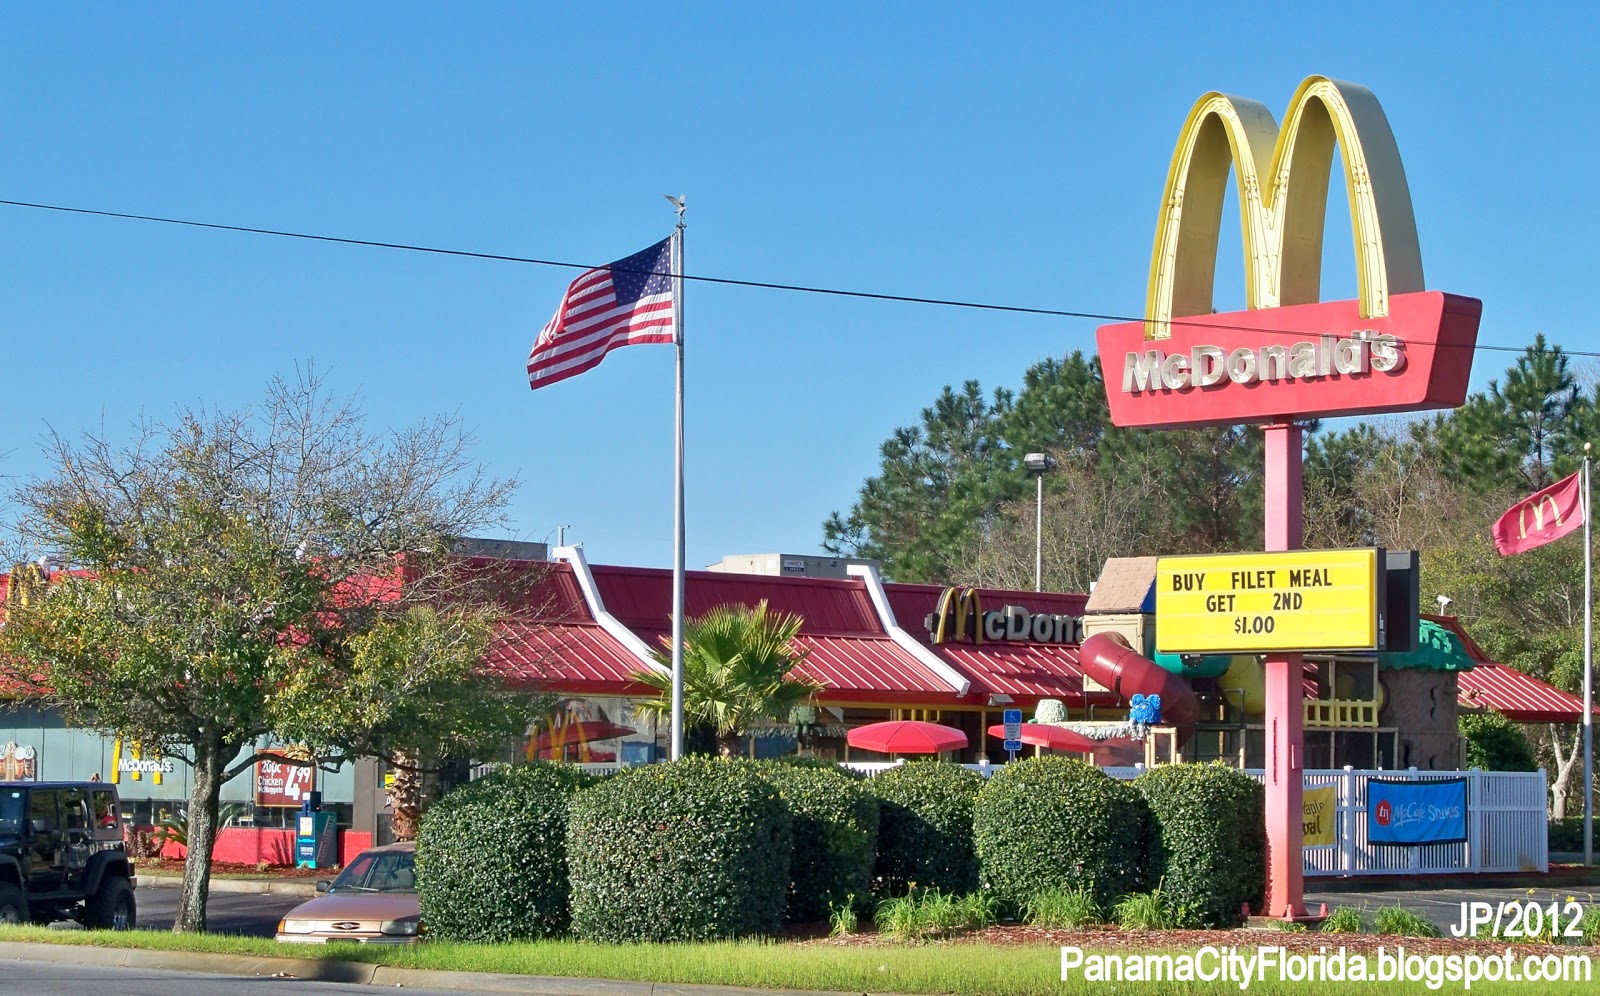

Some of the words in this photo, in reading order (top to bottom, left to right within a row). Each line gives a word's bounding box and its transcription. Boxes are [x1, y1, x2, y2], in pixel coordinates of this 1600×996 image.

[1121, 329, 1406, 393] McDonald's
[1172, 573, 1206, 592] BUY
[1231, 570, 1276, 590] FILET
[1289, 568, 1333, 588] MEAL
[1206, 594, 1236, 613] GET
[1272, 592, 1303, 611] 2ND
[1234, 616, 1275, 635] $1.00
[257, 775, 283, 786] Chicken
